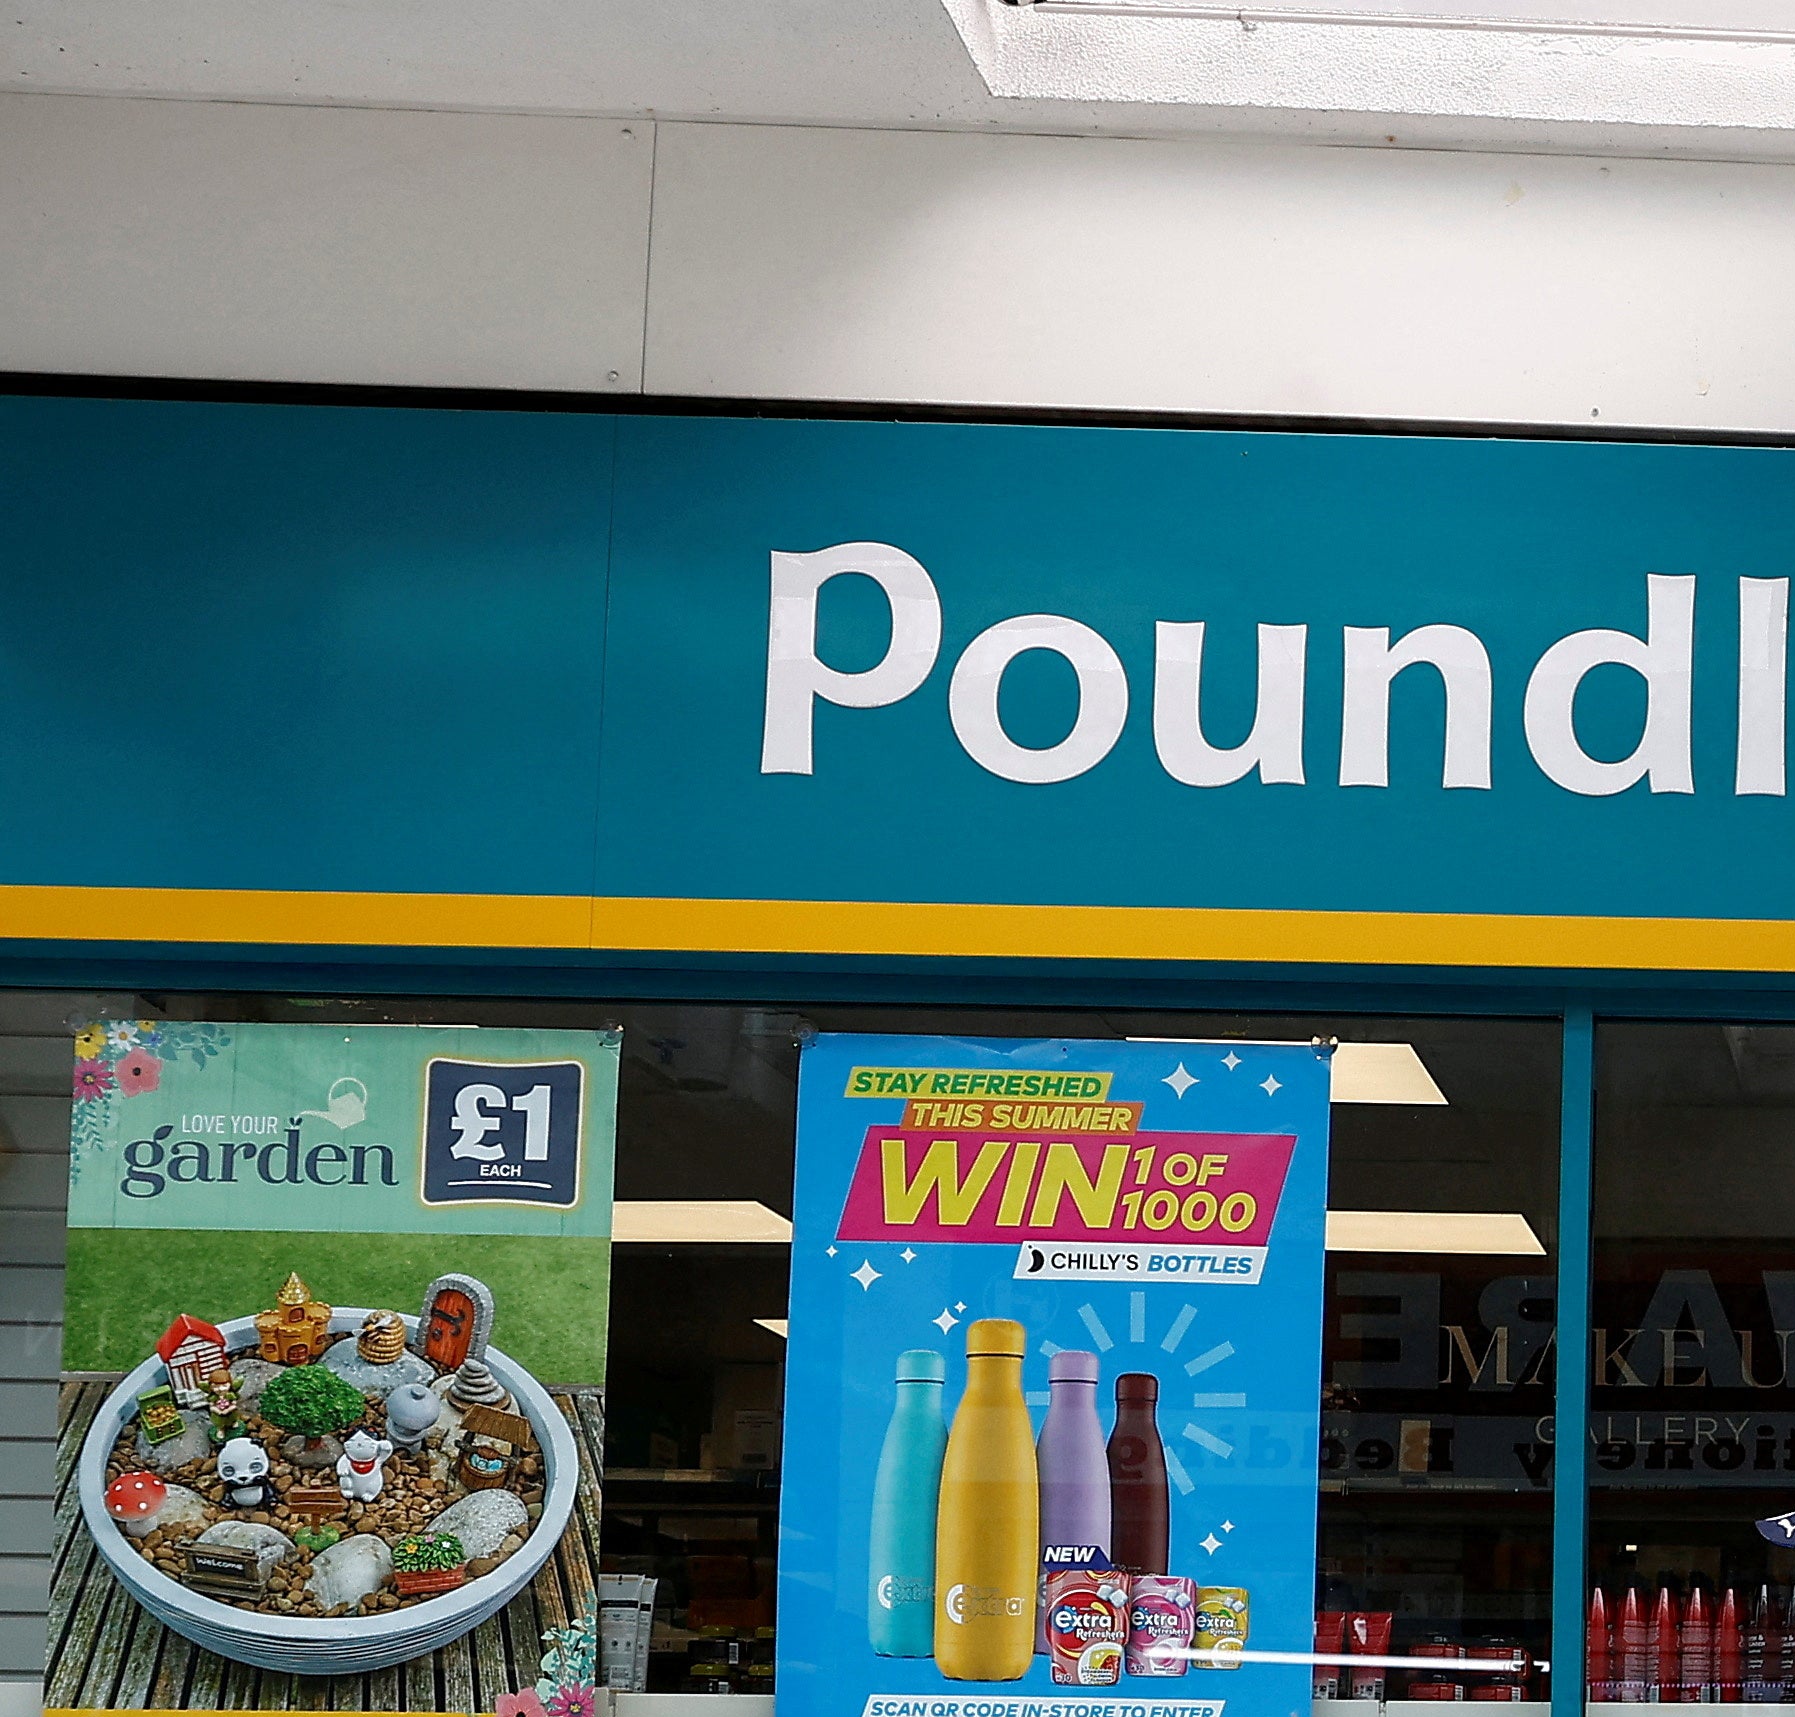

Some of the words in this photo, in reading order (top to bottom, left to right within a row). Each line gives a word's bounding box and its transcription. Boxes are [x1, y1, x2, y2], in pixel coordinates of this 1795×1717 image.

[853, 1072, 926, 1094] STAY
[931, 1074, 1101, 1098] REFRESHED
[182, 1114, 225, 1134] LOVE
[231, 1115, 278, 1134] YOUR
[450, 1083, 552, 1162] £1
[911, 1103, 983, 1128] THIS
[989, 1105, 1134, 1131] SUMMER
[120, 1118, 400, 1198] garden
[1132, 1146, 1156, 1186] 1
[1162, 1153, 1228, 1187] OF
[479, 1164, 521, 1177] EACH
[880, 1138, 1132, 1229] WIN
[1121, 1190, 1258, 1233] 1000
[1050, 1252, 1139, 1271] CHILLY'S
[1147, 1255, 1253, 1275] BOTTLES
[1534, 1415, 1751, 1446] GLLERY
[1044, 1546, 1096, 1562] NEW
[1055, 1607, 1112, 1628] extra
[1130, 1608, 1178, 1626] extra
[1196, 1613, 1235, 1629] extra
[871, 1702, 927, 1717] SCAN
